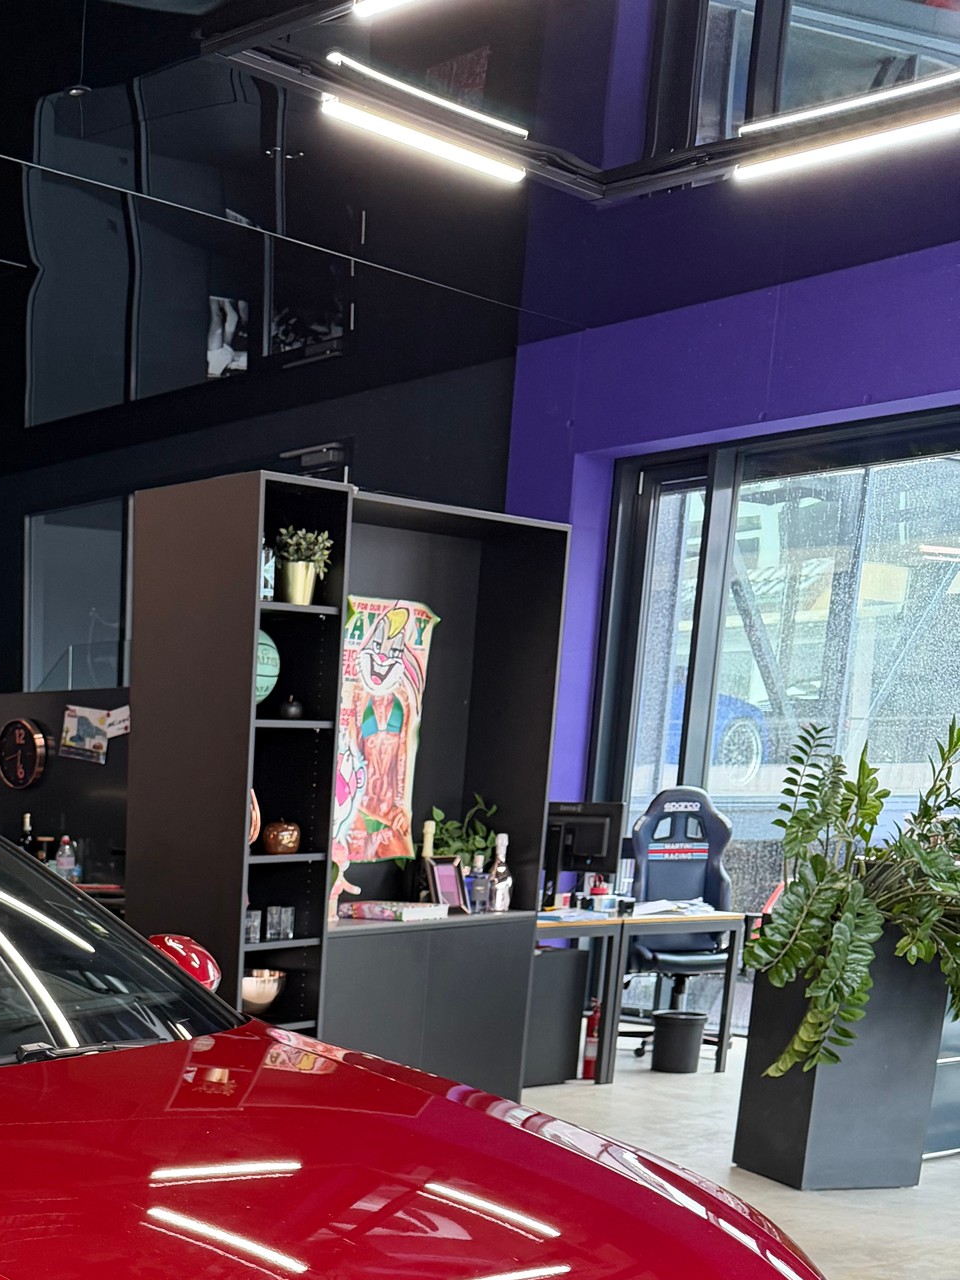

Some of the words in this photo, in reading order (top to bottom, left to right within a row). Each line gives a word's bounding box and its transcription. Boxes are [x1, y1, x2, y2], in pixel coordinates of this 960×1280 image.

[15, 729, 26, 744] 12
[17, 764, 25, 779] 6
[664, 842, 693, 850] MARTINI
[663, 852, 693, 860] RACING
